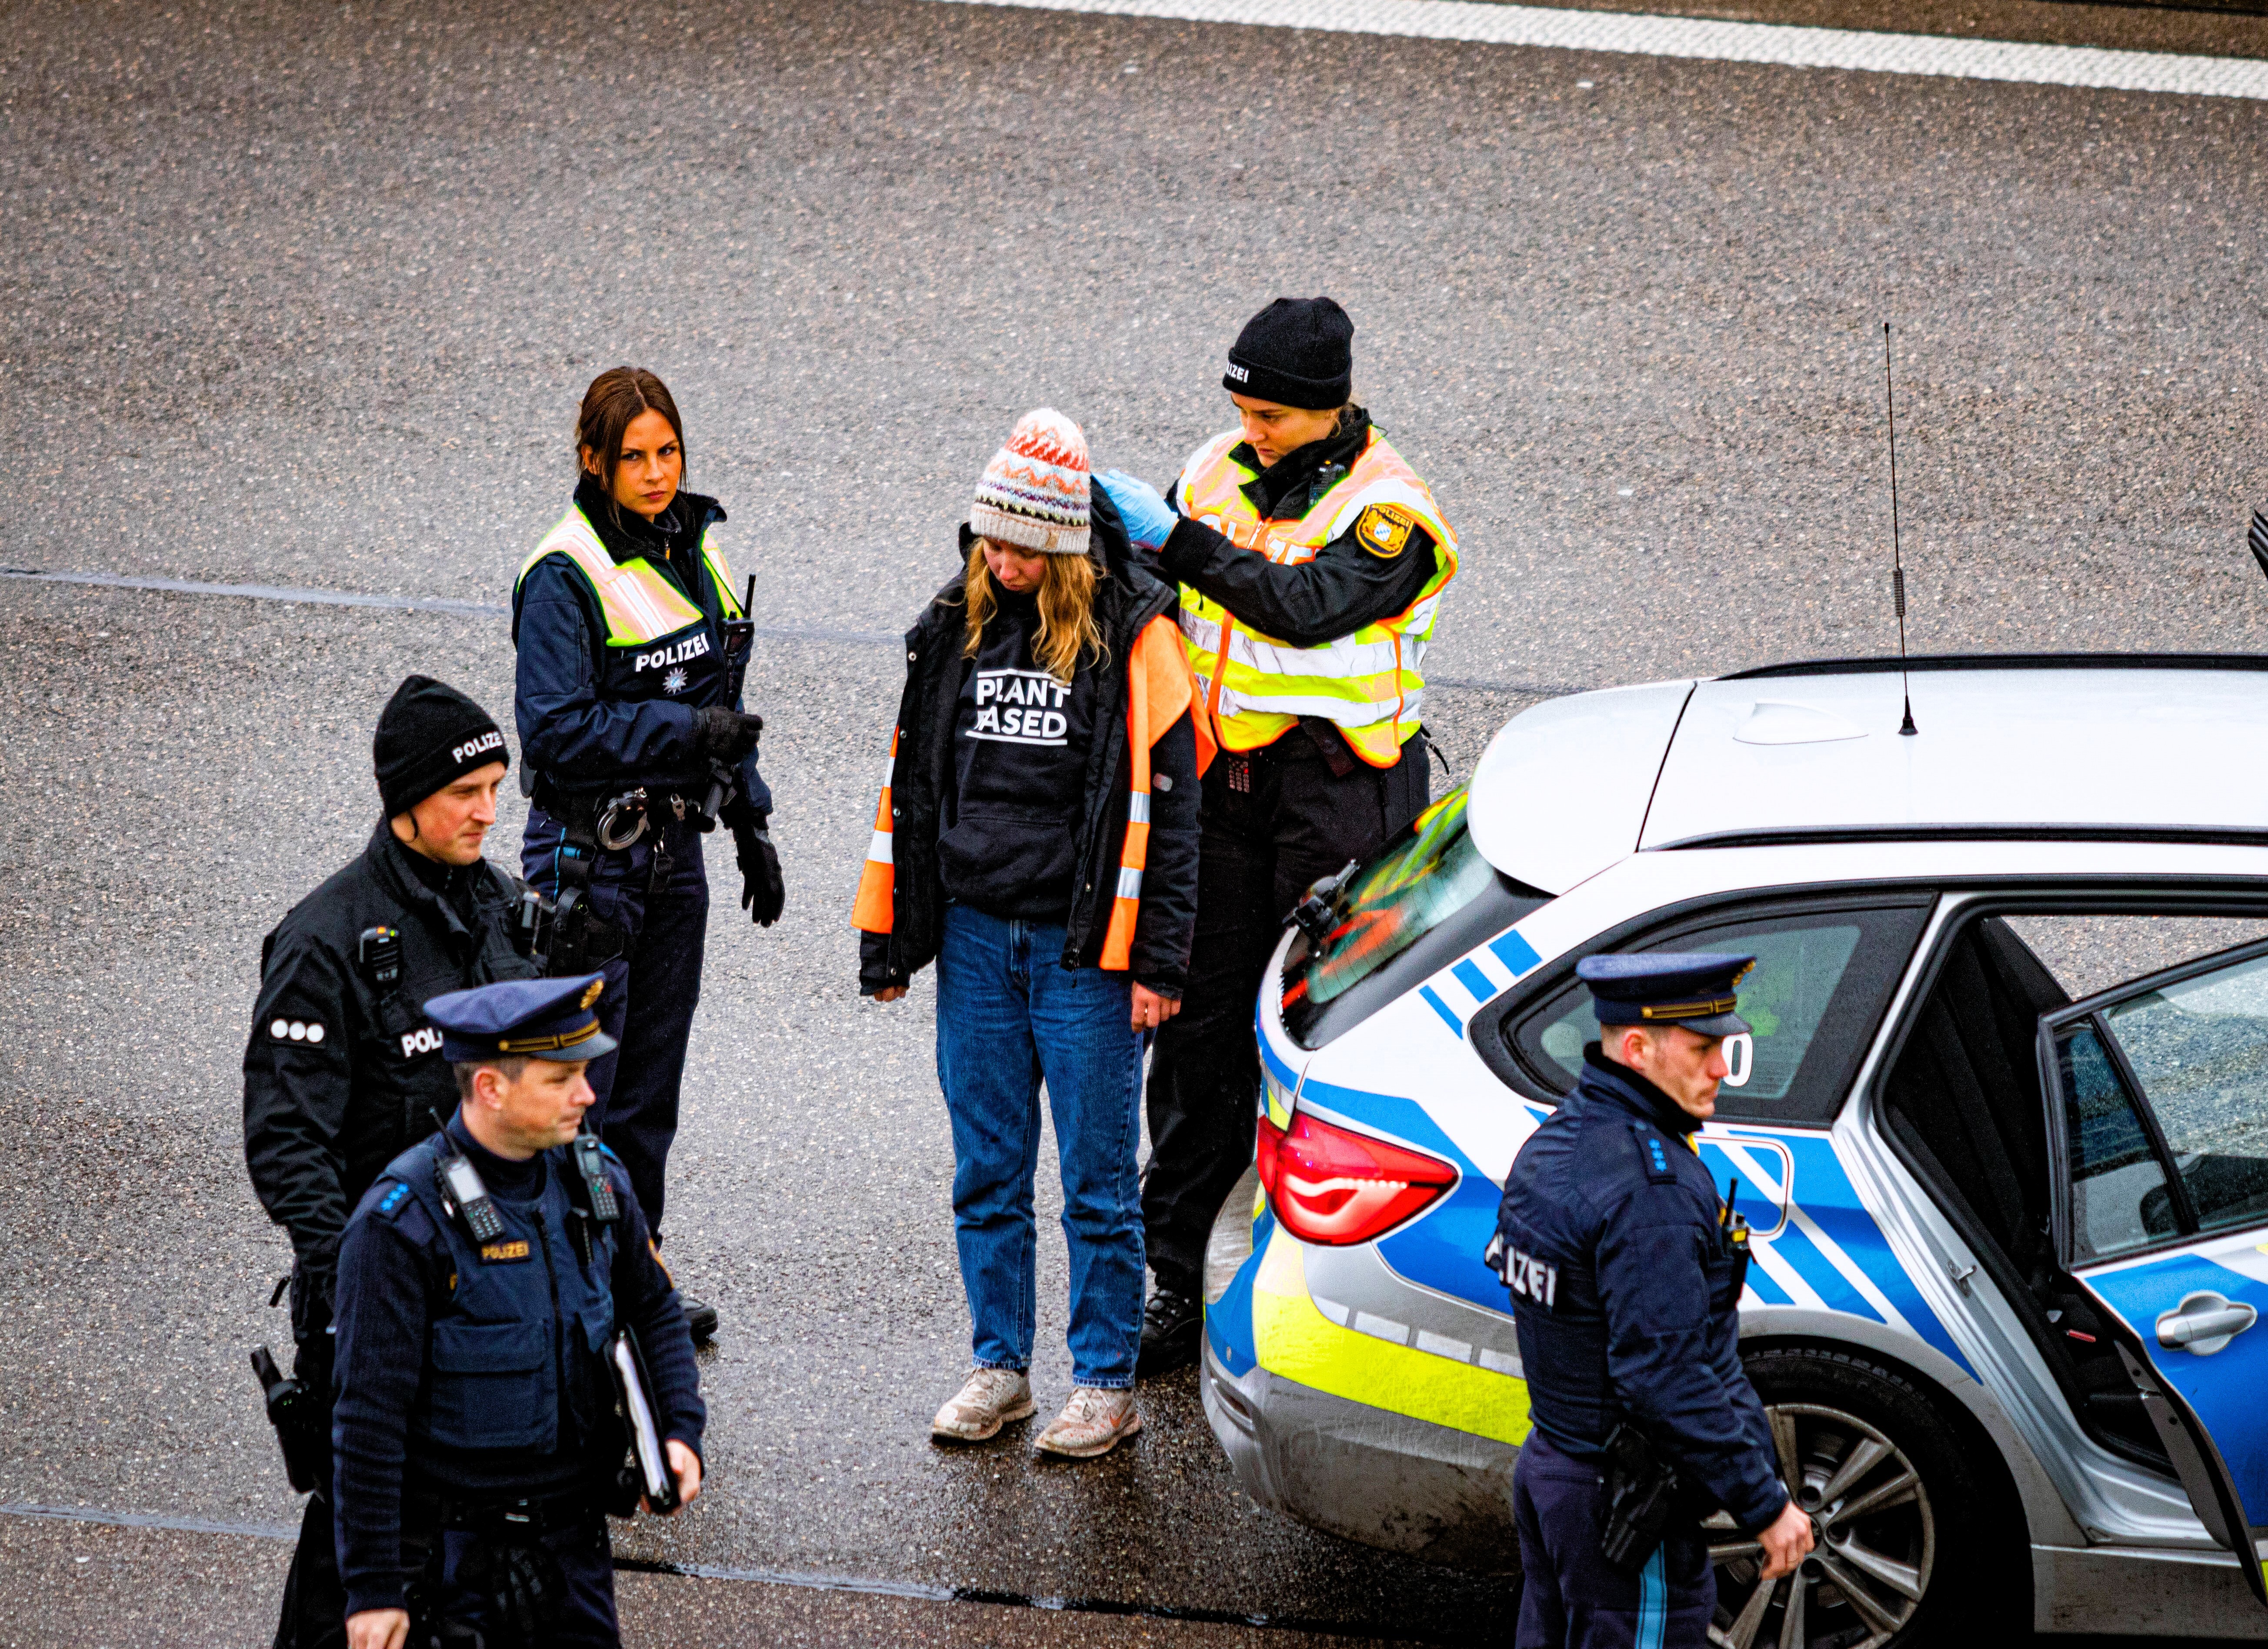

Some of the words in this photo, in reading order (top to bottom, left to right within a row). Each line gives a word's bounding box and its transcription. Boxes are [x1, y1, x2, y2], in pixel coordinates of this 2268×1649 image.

[636, 633, 710, 672] POLIZEI
[977, 677, 1071, 708] PLANT
[481, 1240, 529, 1259] POLIZEI
